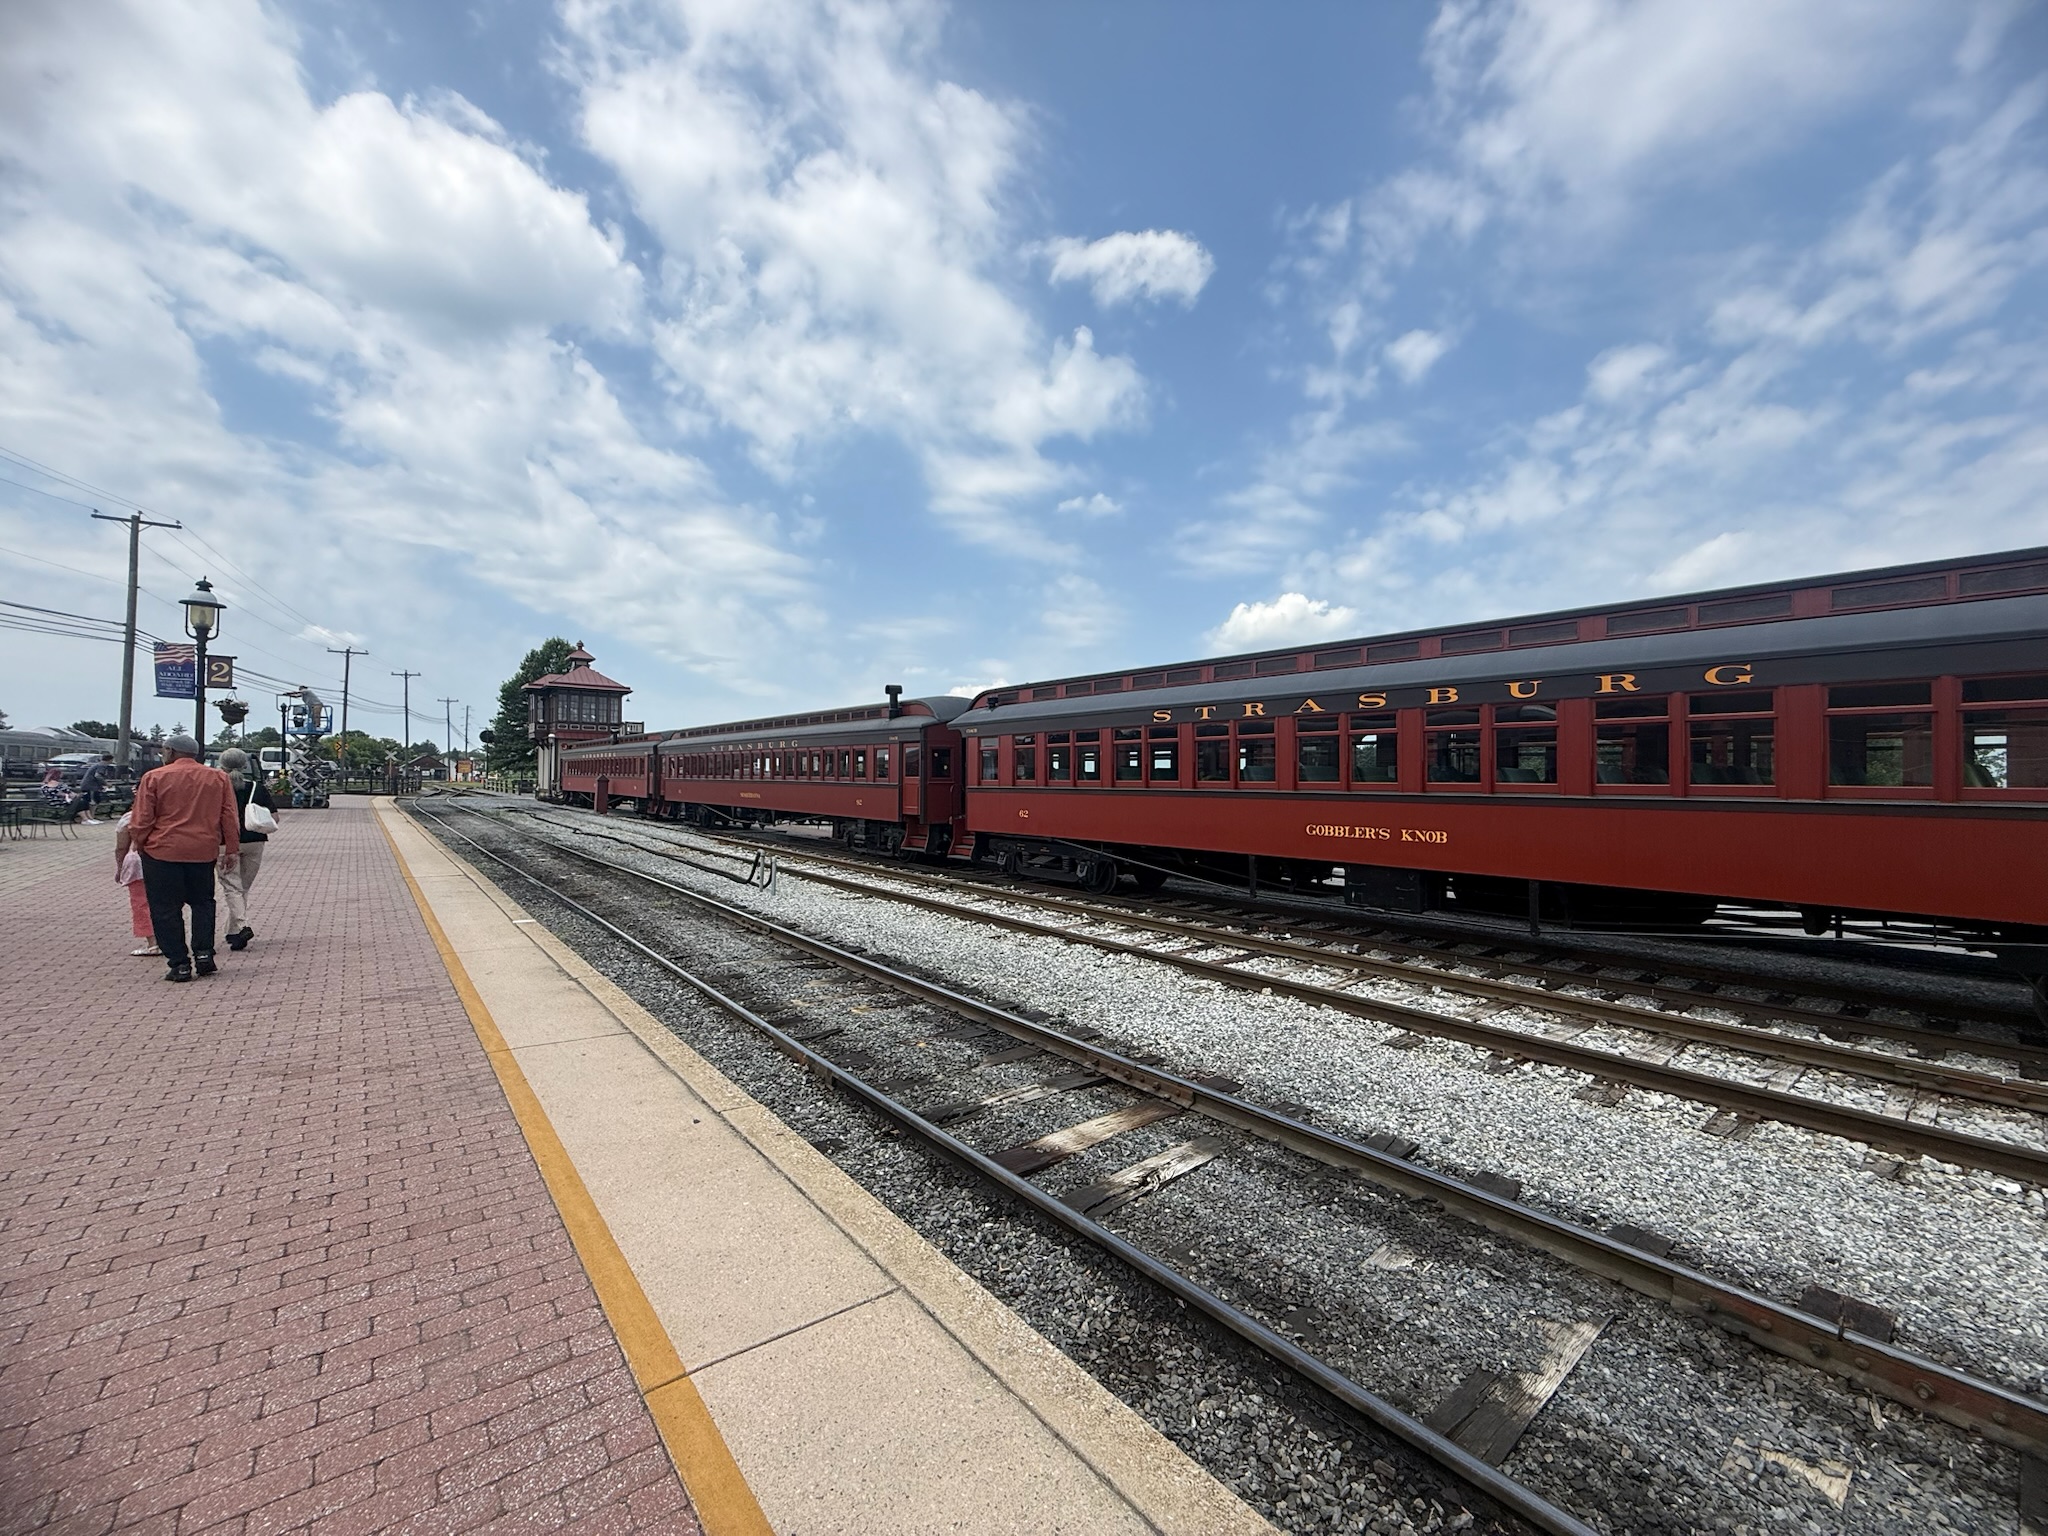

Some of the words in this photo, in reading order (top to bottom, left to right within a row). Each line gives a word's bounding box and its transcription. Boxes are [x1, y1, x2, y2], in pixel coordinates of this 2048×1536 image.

[210, 661, 230, 682] 2
[1152, 663, 1755, 723] STRASBURG
[711, 740, 798, 752] STRASBURG
[1018, 809, 1029, 818] 62
[1305, 823, 1391, 841] GOBBLER'S
[1400, 829, 1448, 844] KNOB
